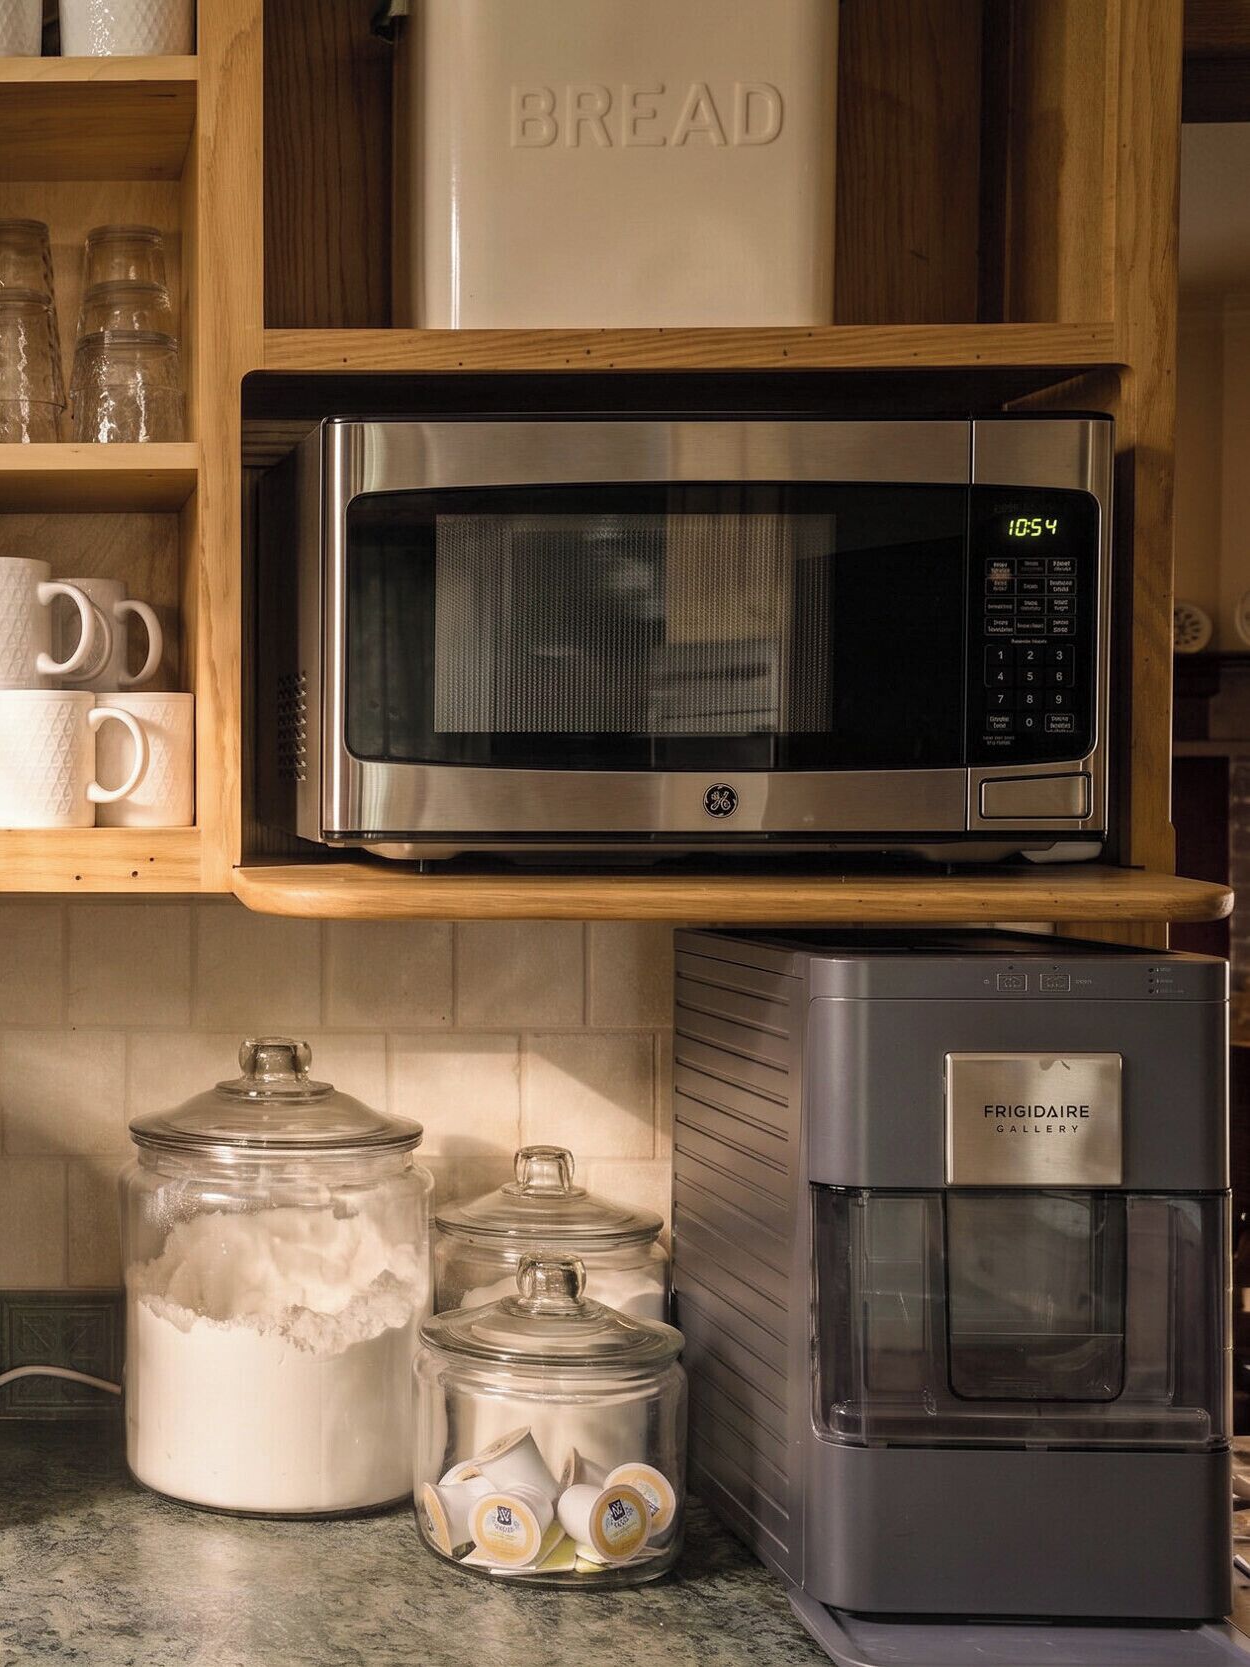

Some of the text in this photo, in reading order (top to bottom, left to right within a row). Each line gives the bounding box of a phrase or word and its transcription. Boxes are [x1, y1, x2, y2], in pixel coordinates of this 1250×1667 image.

[509, 81, 784, 149] BREAD
[1008, 518, 1058, 537] 10:54
[1027, 650, 1034, 660] 2
[1056, 650, 1063, 661] 3
[997, 671, 1063, 681] 4 5 6
[997, 694, 1062, 705] 7 8 9
[1025, 717, 1033, 727] 0
[984, 1104, 1090, 1118] FRIGIDAIRE
[996, 1124, 1079, 1133] GALLERY
